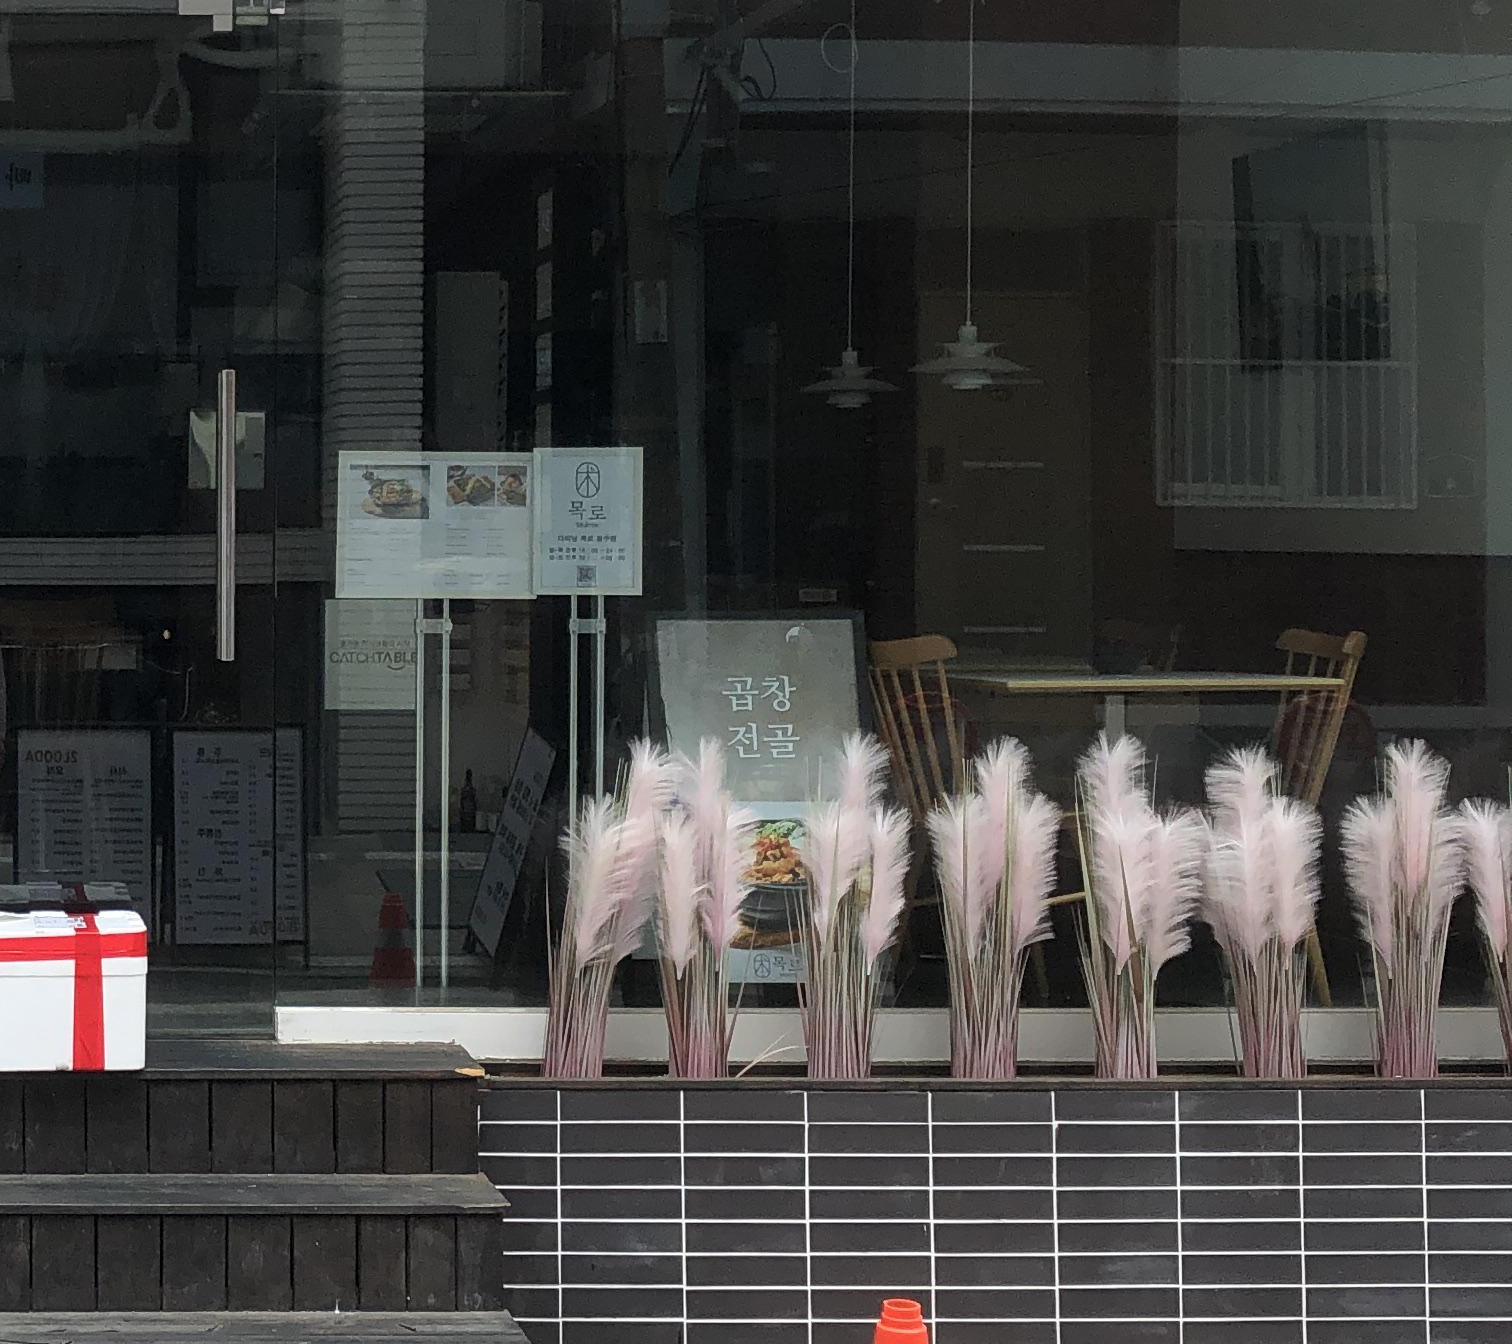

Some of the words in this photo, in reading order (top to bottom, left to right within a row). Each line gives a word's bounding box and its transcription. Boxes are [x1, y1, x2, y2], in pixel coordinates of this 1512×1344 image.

[569, 500, 607, 521] 목로
[722, 674, 797, 713] 곱창
[727, 721, 801, 760] 전골
